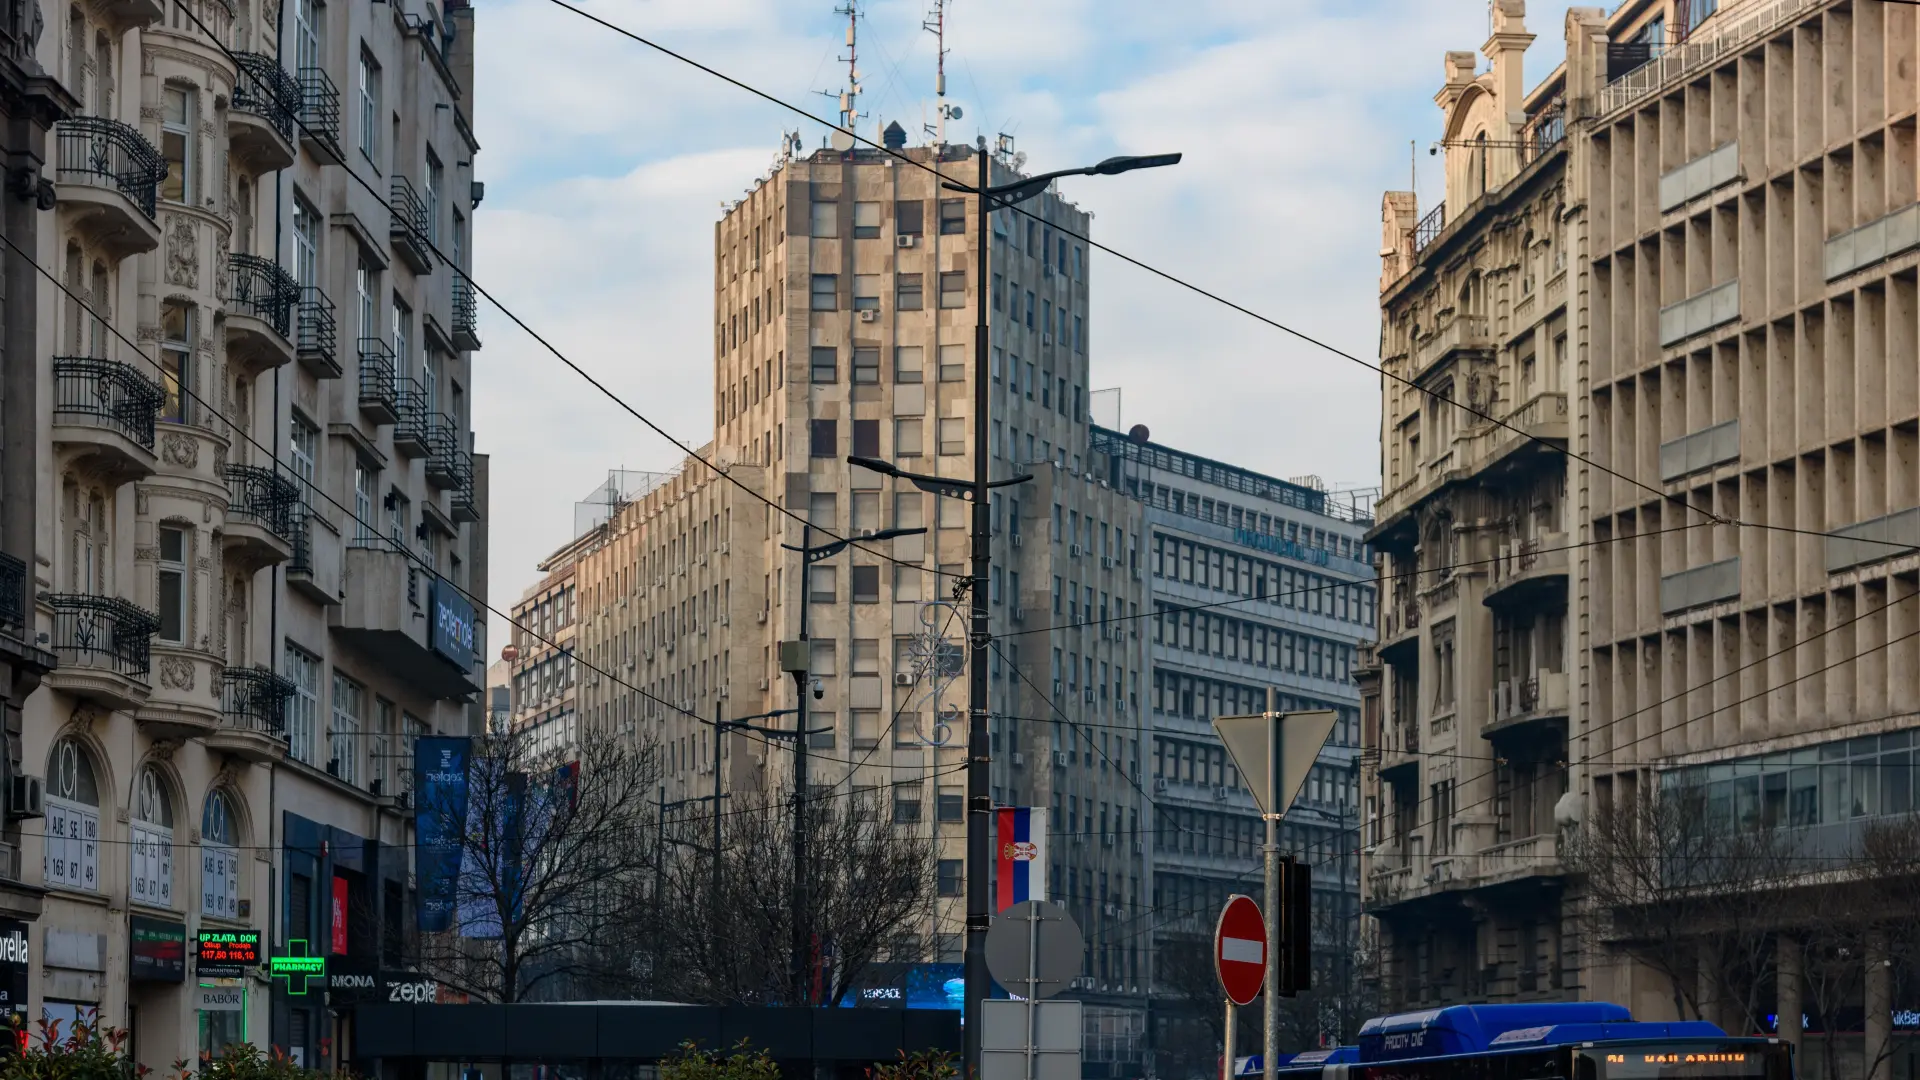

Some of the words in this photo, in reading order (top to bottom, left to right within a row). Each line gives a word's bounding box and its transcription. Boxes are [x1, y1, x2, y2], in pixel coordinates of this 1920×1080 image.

[53, 858, 63, 876] 163
[70, 862, 78, 879] 87
[212, 934, 236, 943] ZLATA
[240, 934, 257, 943] DOK
[273, 963, 322, 971] PHARMACY
[331, 975, 375, 988] MONA
[863, 988, 901, 998] VERSACE
[203, 994, 241, 1004] BABOR
